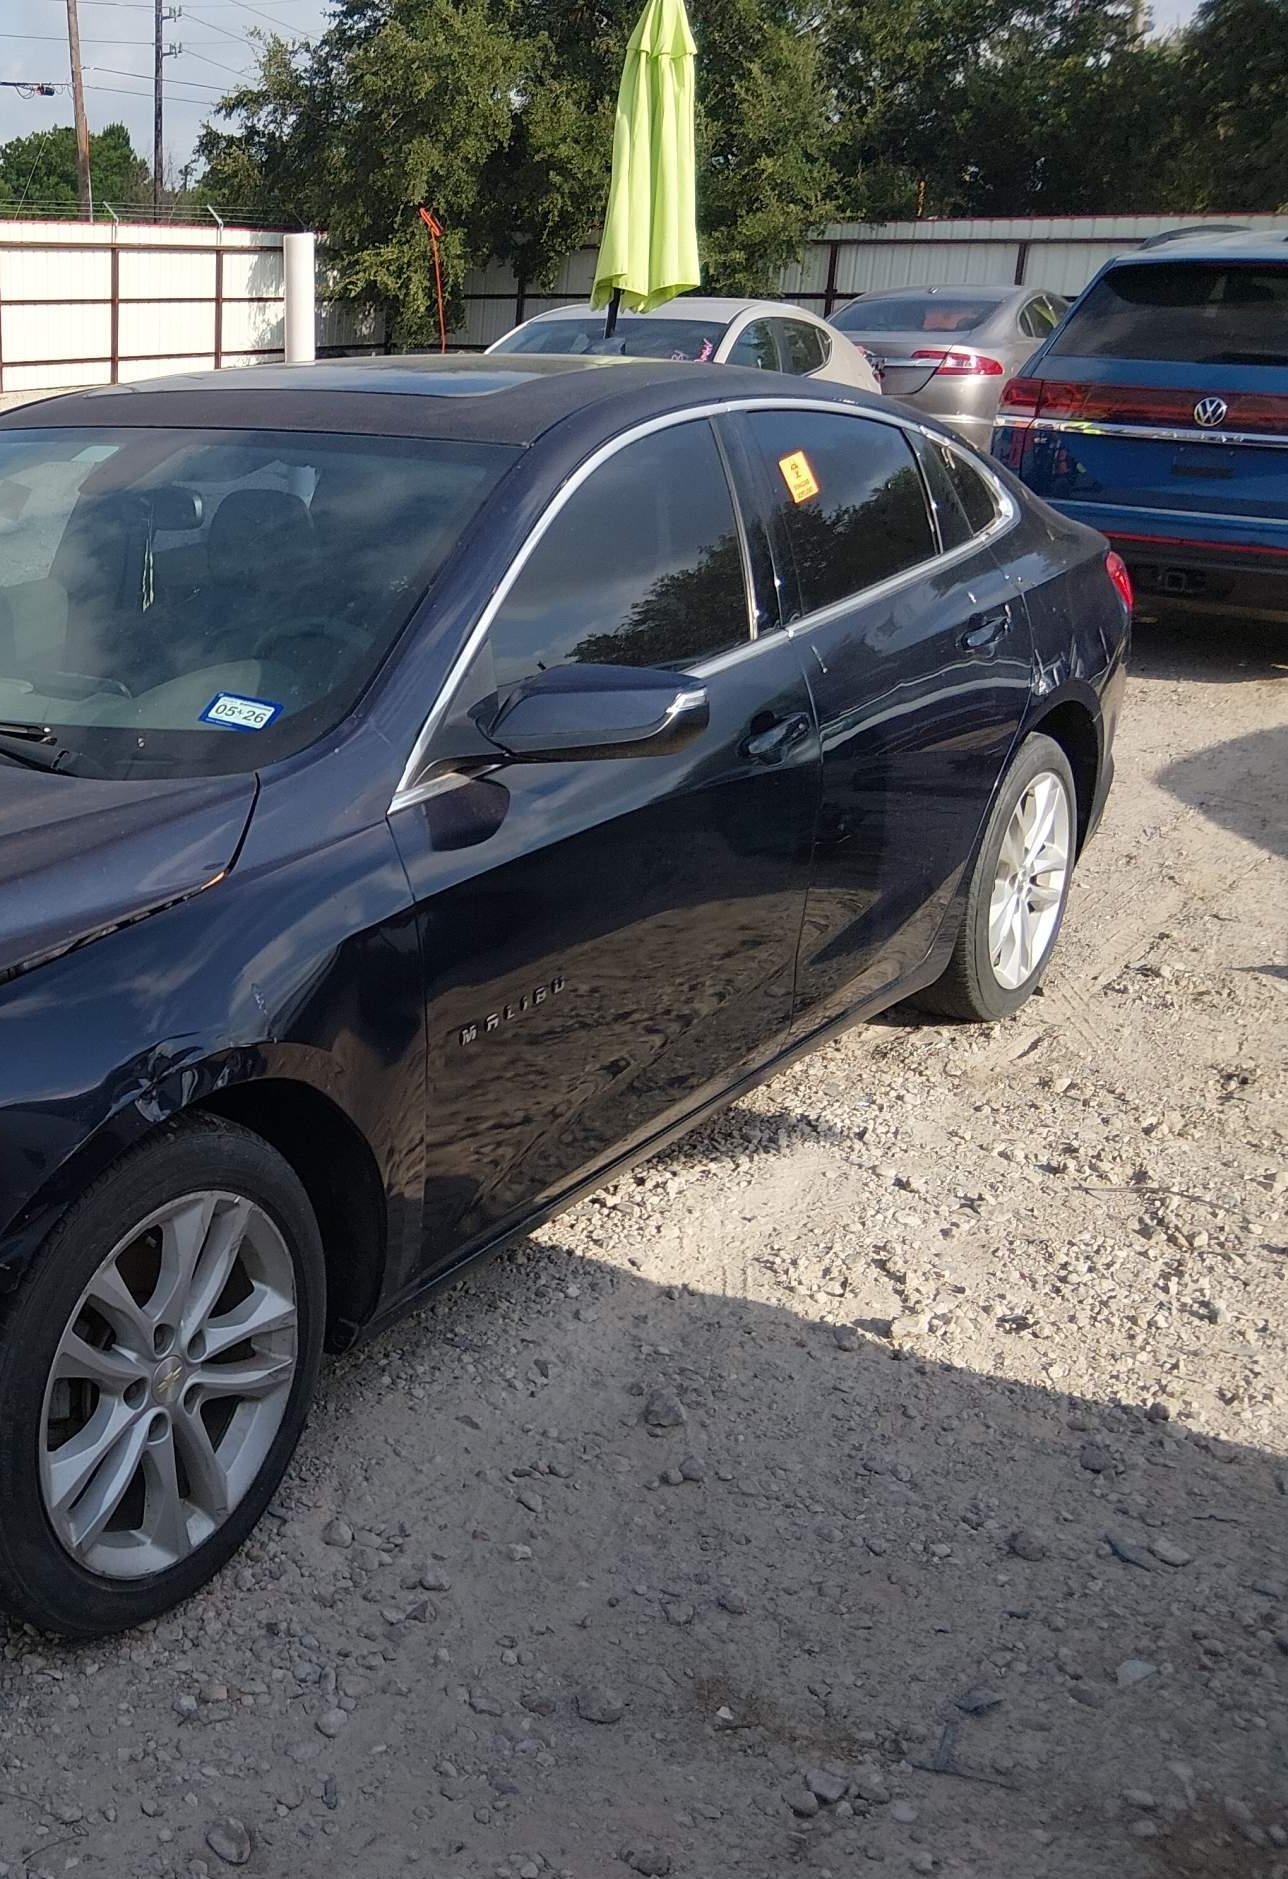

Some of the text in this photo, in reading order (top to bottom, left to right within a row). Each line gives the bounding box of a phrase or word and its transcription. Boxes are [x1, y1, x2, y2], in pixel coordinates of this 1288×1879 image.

[215, 704, 238, 717] 05
[242, 710, 267, 723] 26
[460, 975, 565, 1046] MALIBU
